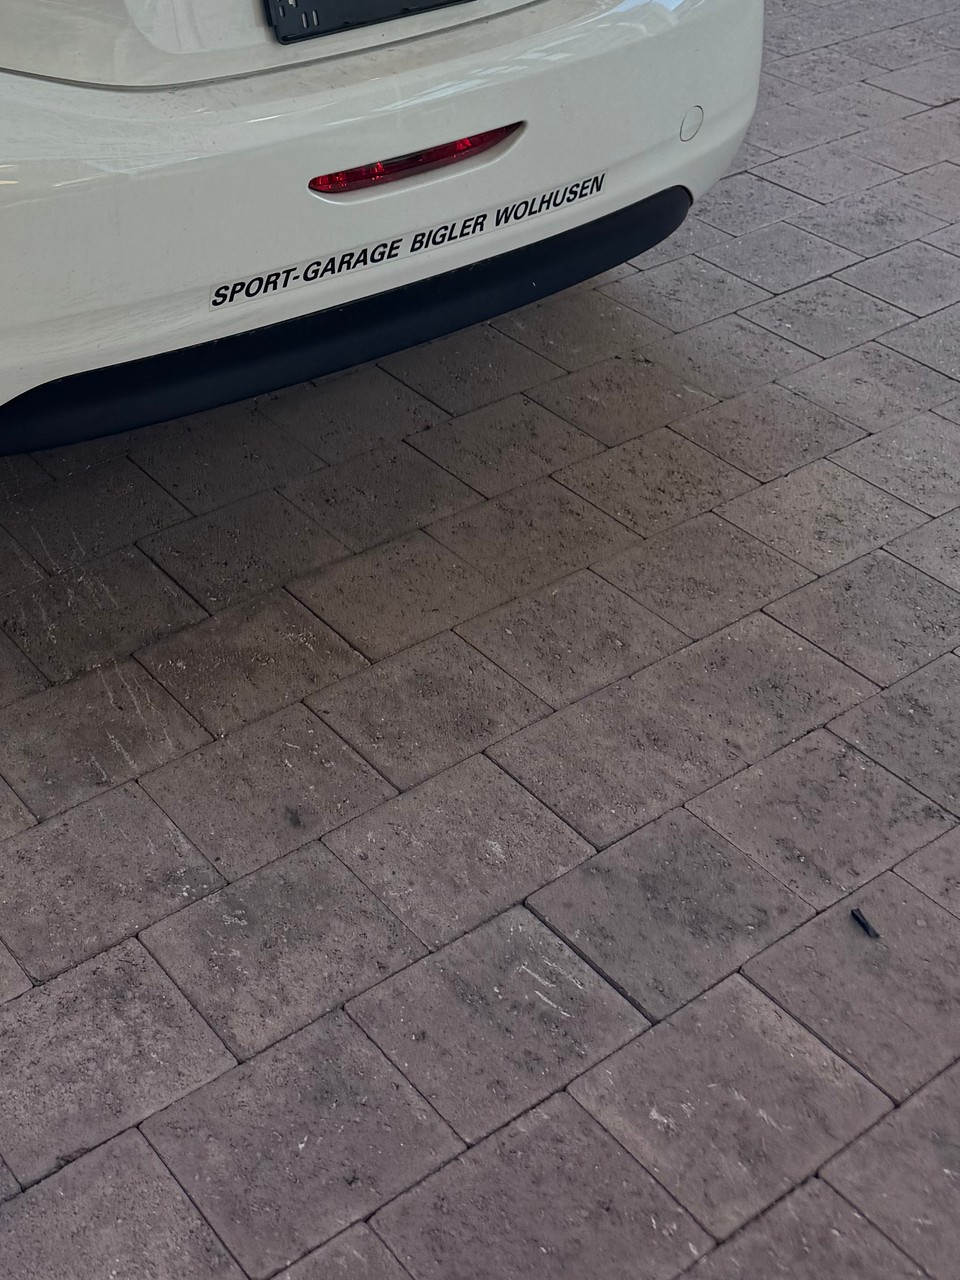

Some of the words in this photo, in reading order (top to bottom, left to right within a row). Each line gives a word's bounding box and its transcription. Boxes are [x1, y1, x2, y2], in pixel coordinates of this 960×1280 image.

[211, 238, 403, 307] SPORT-GARAGE
[409, 213, 487, 254] BIGLER
[495, 173, 607, 228] WOLHUSEN
